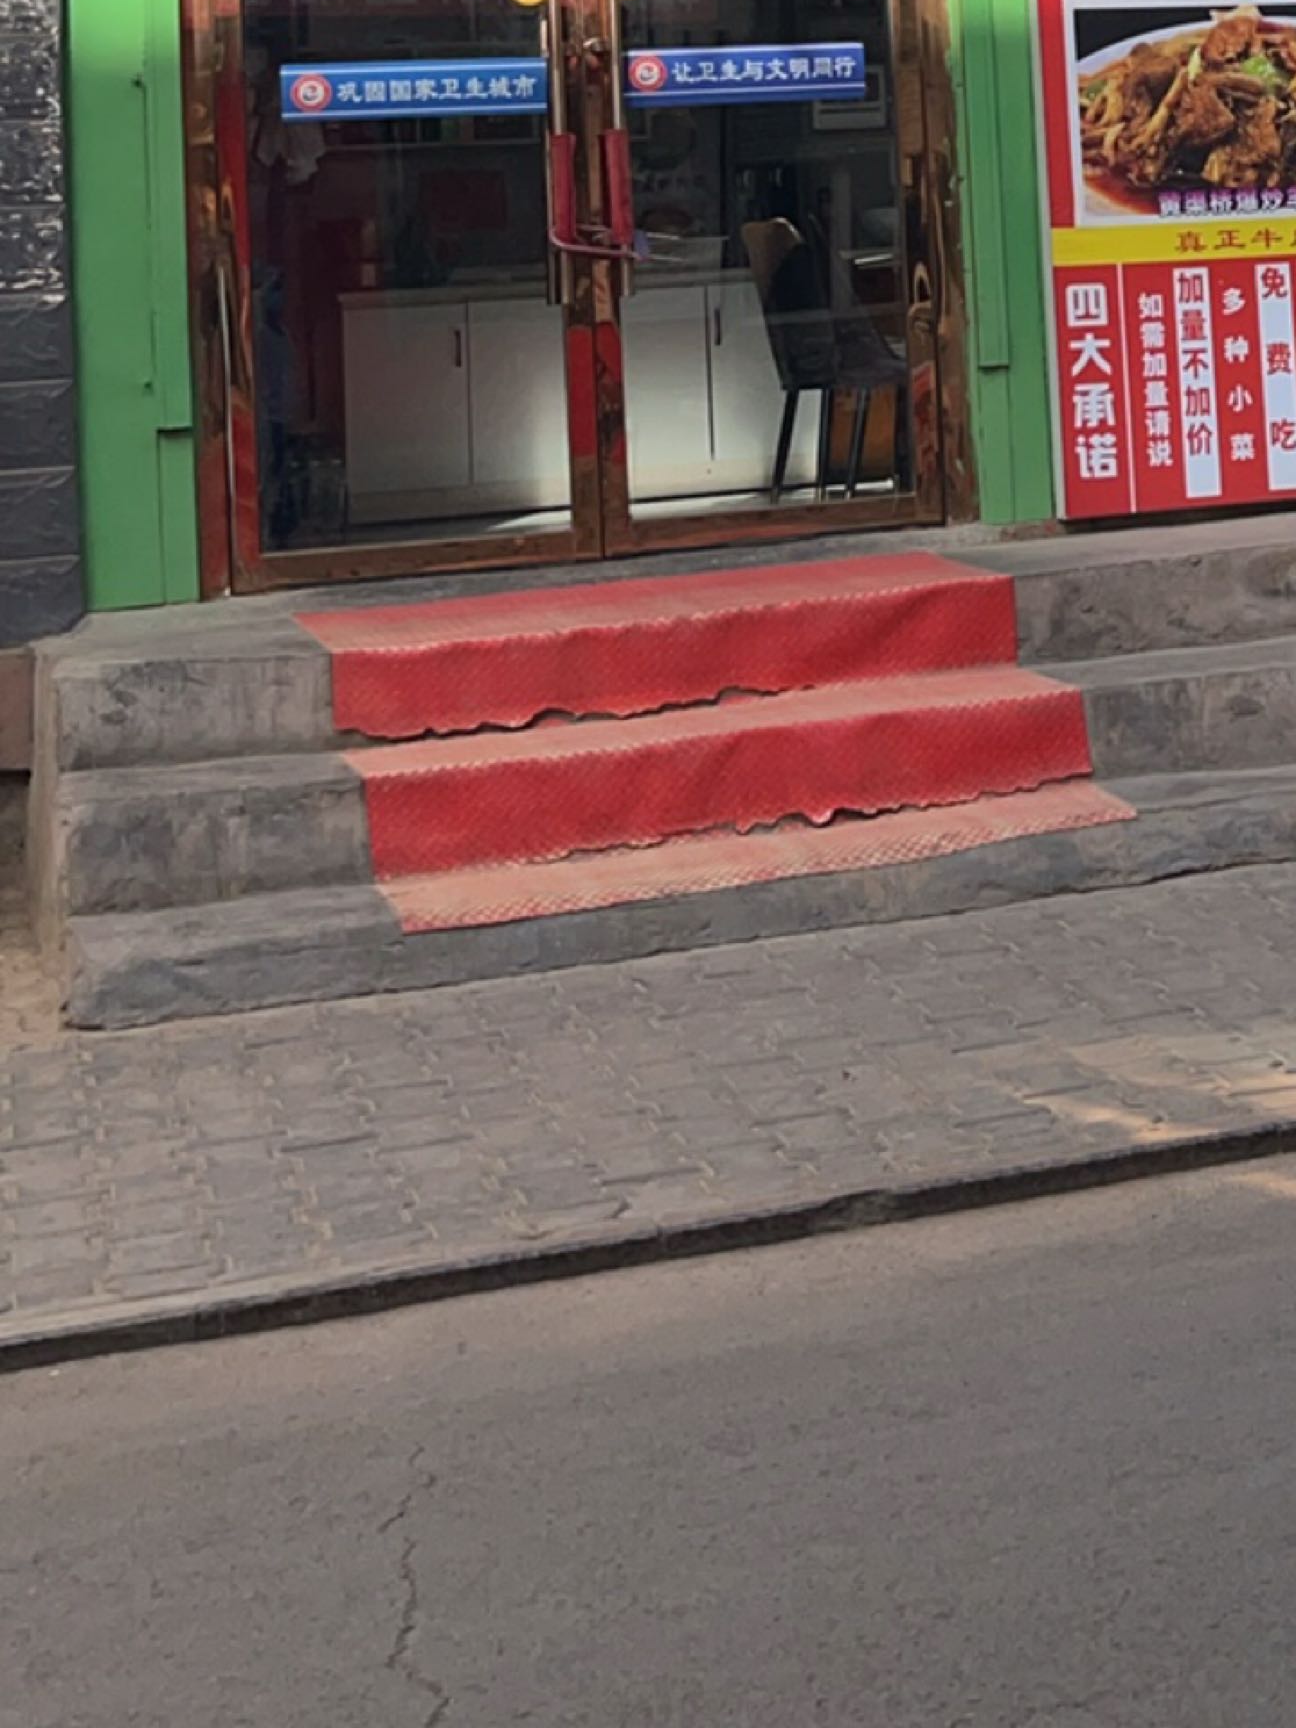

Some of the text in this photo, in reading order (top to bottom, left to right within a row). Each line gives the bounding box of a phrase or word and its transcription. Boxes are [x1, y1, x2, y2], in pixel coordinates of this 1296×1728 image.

[336, 74, 537, 103] 巩固国家卫生城市
[671, 56, 857, 84] 让卫生与文明同行
[1066, 282, 1119, 479] 四大承诺
[1178, 273, 1214, 457] 加量不加价
[1222, 287, 1256, 461] 多种小菜
